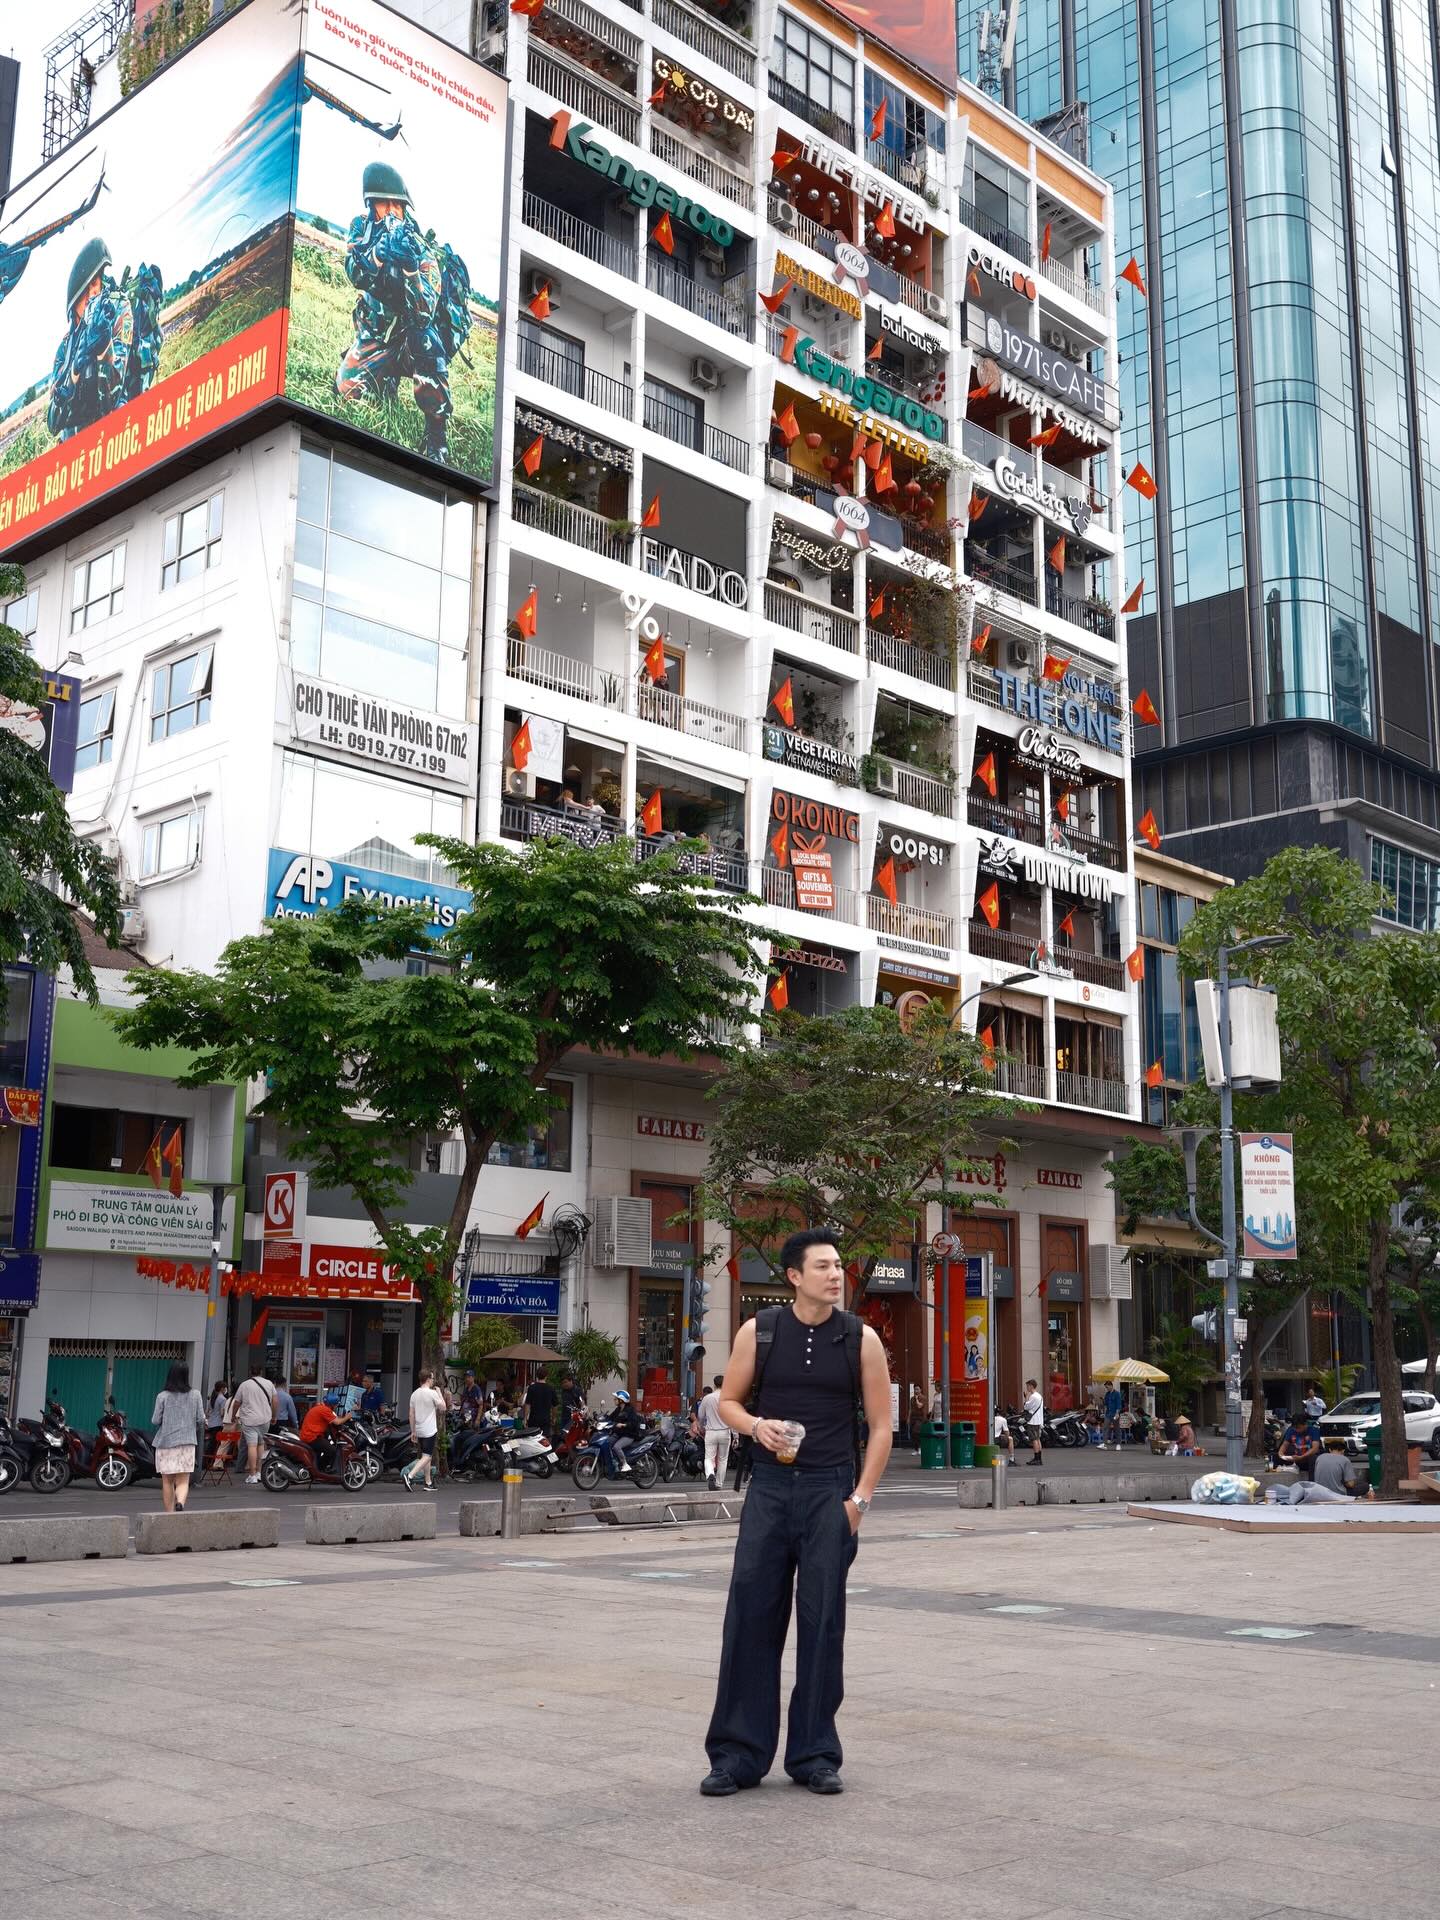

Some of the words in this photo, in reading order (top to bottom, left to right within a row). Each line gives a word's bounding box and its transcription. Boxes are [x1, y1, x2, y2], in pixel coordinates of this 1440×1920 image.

[724, 101, 755, 132] DAY
[548, 109, 735, 248] Kangaroo
[803, 134, 848, 184] THE
[850, 165, 926, 235] LETTER
[839, 247, 866, 272] 1664
[780, 325, 943, 440] Kangaroo
[1052, 358, 1105, 414] CAFE
[44, 461, 67, 506] BẢO
[70, 451, 85, 493] VỆ
[88, 430, 104, 480] TỔ
[146, 400, 172, 447] BẢO
[176, 386, 193, 432] VỆ
[195, 372, 223, 418] HÒA
[227, 346, 268, 400] BÌNH!
[819, 390, 855, 428] THE
[859, 413, 929, 464] LETTER
[994, 455, 1075, 521] Carlsberg
[838, 501, 867, 524] 1664
[771, 517, 829, 564] Saigon
[641, 536, 749, 608] FADO
[296, 683, 323, 717] CHO
[327, 693, 359, 728] THUÊ
[363, 701, 388, 737] VĂN
[391, 710, 433, 746] PHÒNG
[436, 725, 468, 759] 67m2
[993, 669, 1056, 725] THE
[1063, 699, 1122, 750] ONE
[319, 723, 343, 745] LH:
[347, 732, 446, 773] 0919.797.199
[786, 734, 857, 771] VEGETARIAN
[890, 835, 943, 866] OOPS!
[796, 881, 832, 892] SOUVENIRS
[803, 872, 820, 882] GIFTS
[1024, 856, 1112, 904] DOWNTOWN
[1254, 1154, 1280, 1163] KHÔNG
[1040, 1171, 1082, 1187] FAHASA
[53, 1209, 76, 1221] PHỐ
[79, 1212, 90, 1222] ĐI
[93, 1212, 109, 1226] BỘ
[112, 1213, 125, 1224] VÀ
[128, 1215, 158, 1227] CÔNG
[161, 1217, 184, 1228] VIÊN
[187, 1219, 203, 1230] SÀI
[206, 1222, 228, 1232] GN
[91, 1199, 128, 1211] TRUNG
[131, 1200, 151, 1213] TÂM
[155, 1203, 183, 1215] QUẢN
[187, 1204, 199, 1216] LÝ
[316, 1259, 377, 1279] CIRCLE
[875, 1263, 905, 1278] fahasa
[487, 1292, 506, 1304] PHỐ
[508, 1296, 526, 1306] VĂN
[529, 1296, 547, 1306] HÓA
